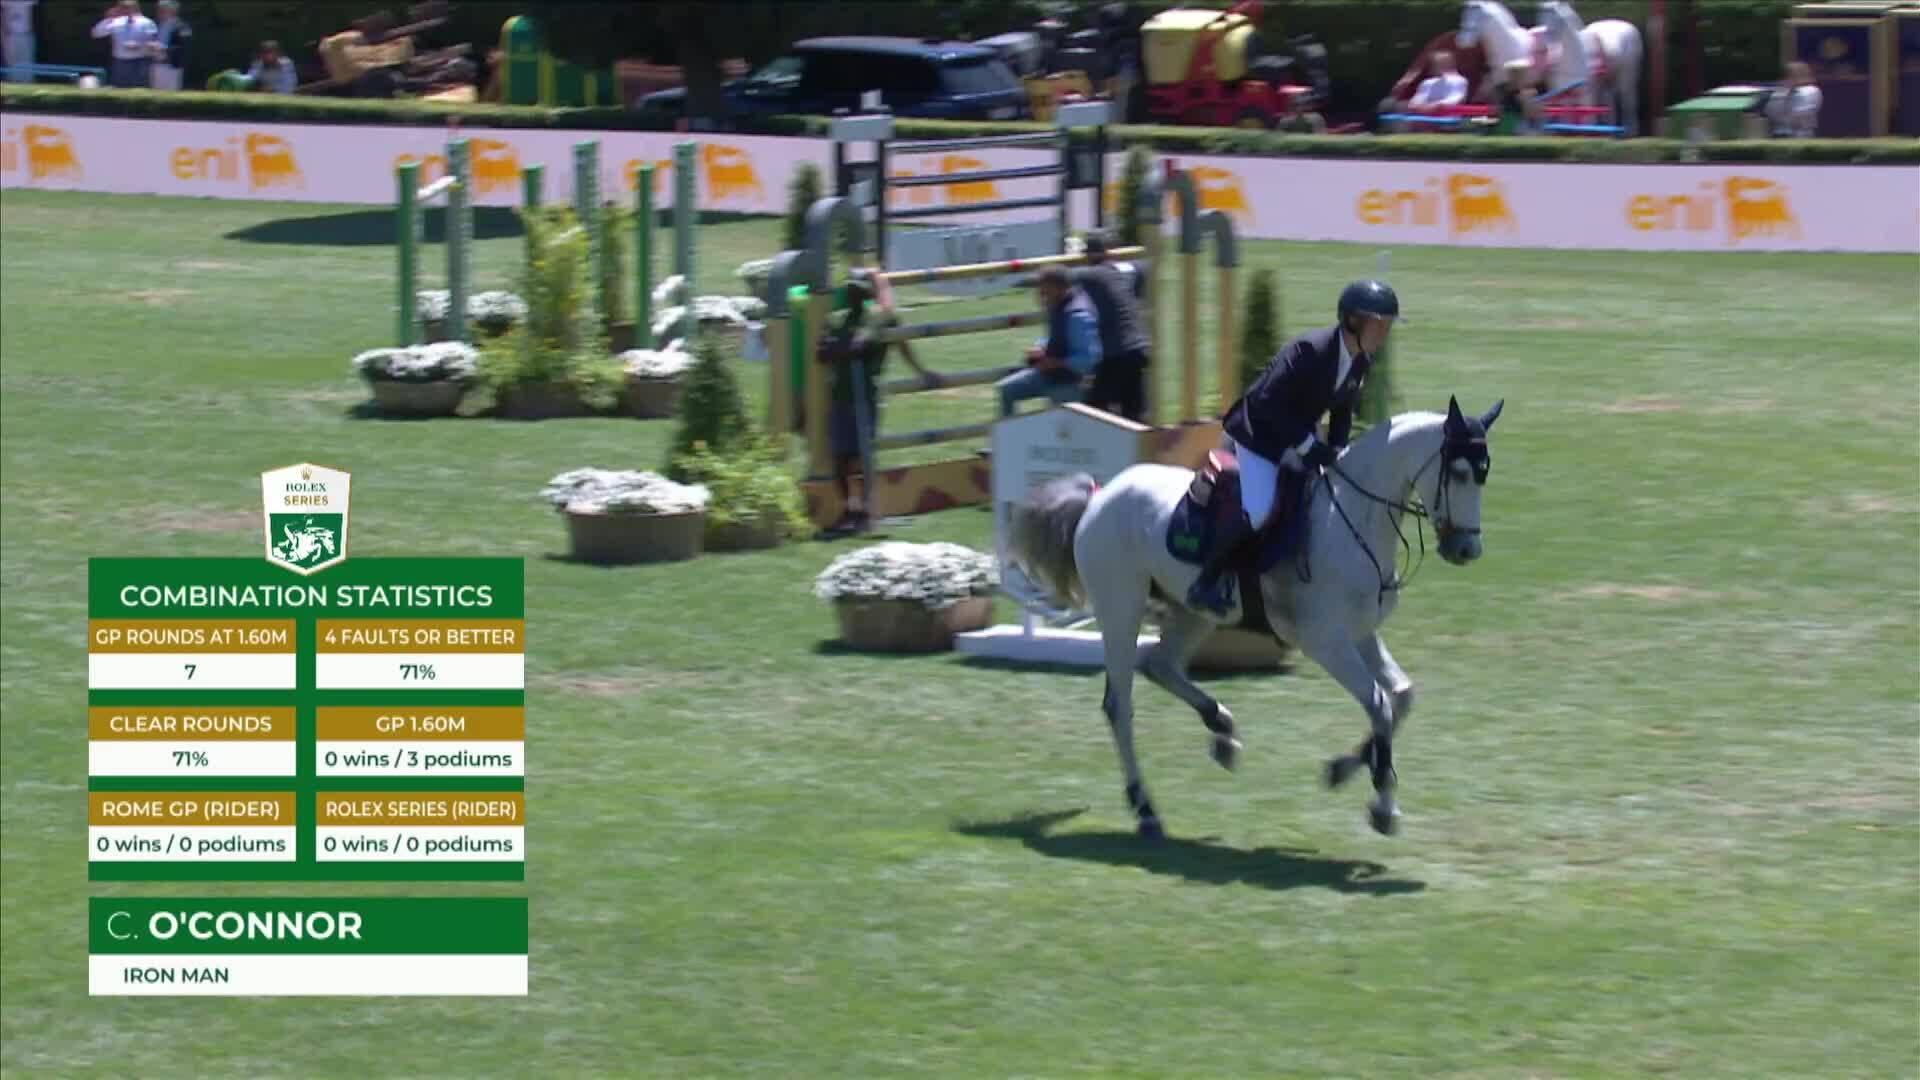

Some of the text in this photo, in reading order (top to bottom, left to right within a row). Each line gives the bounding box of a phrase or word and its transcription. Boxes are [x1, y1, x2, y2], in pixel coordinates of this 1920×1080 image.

[169, 137, 239, 181] eni
[1355, 177, 1438, 226] eni
[1625, 180, 1714, 232] eni
